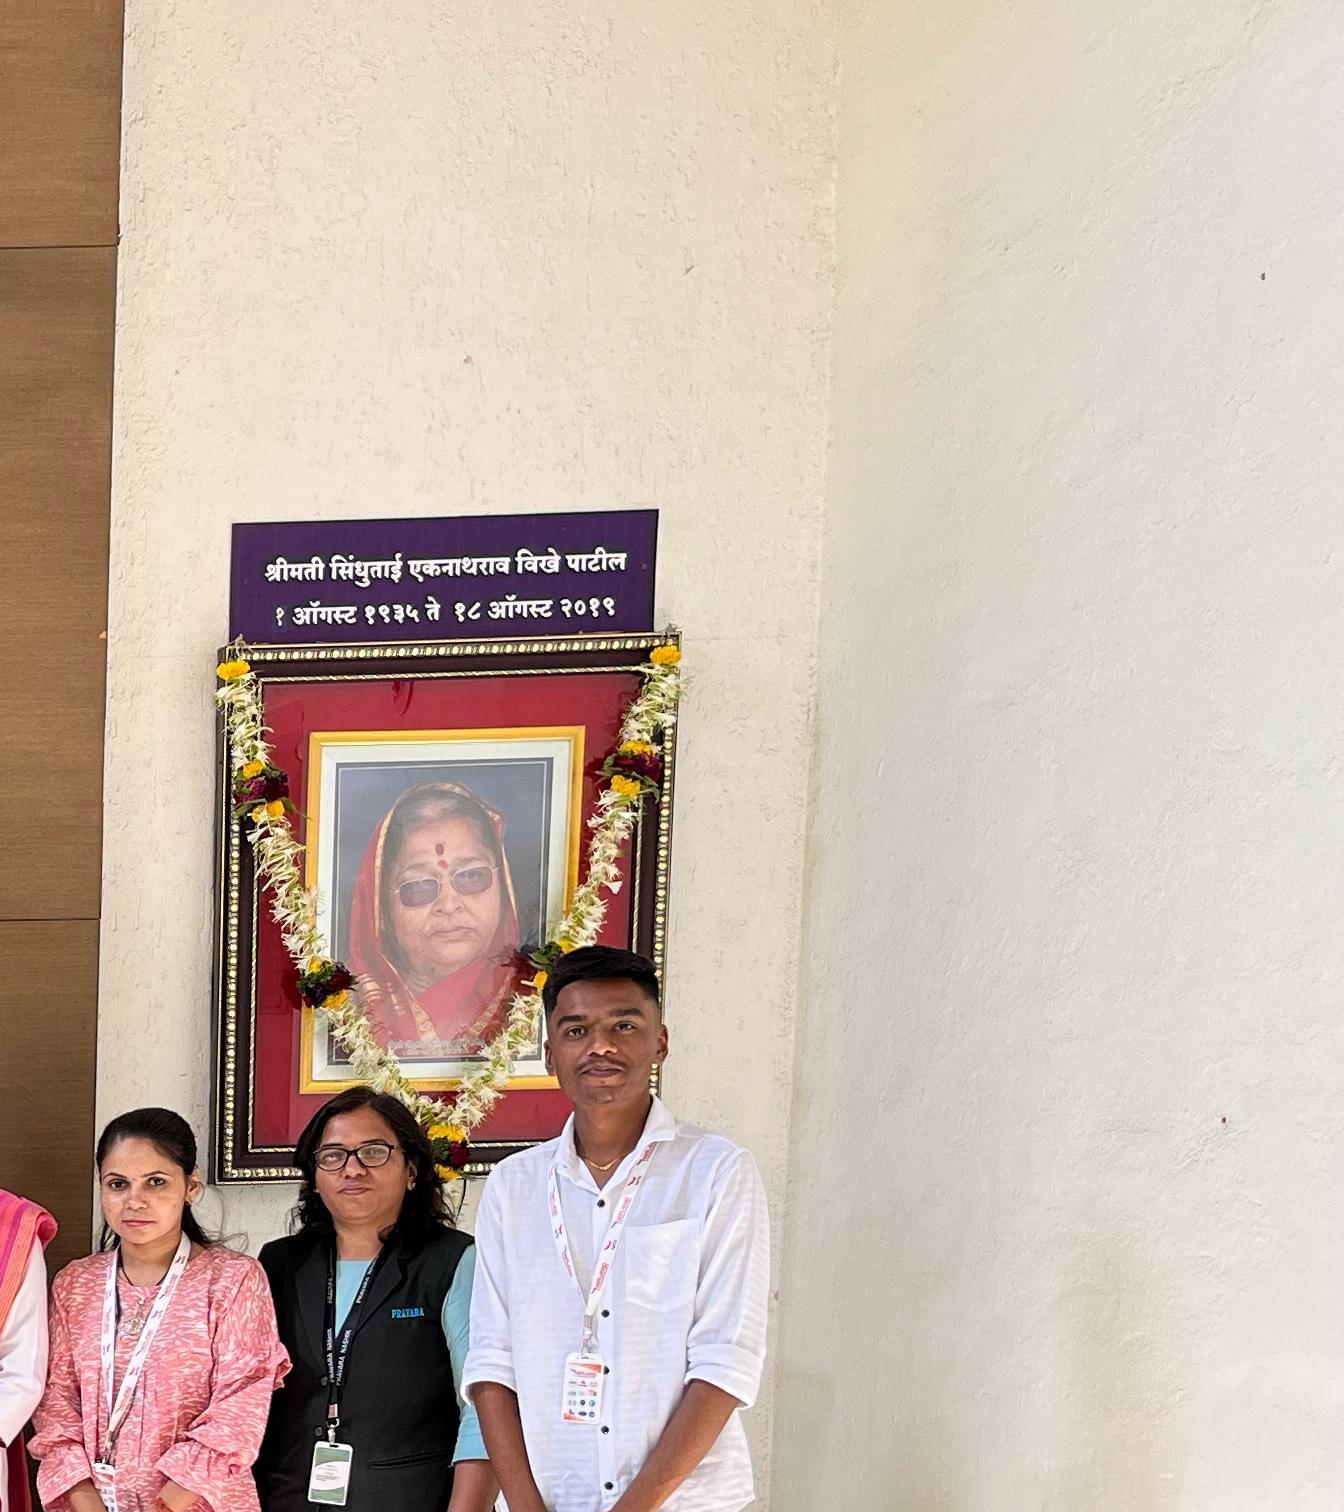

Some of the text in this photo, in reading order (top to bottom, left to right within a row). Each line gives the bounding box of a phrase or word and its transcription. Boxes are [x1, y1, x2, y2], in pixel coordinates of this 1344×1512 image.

[264, 546, 628, 588] श्रीमती सिंधुताई एकनाथराव विखे पाटील
[275, 594, 615, 627] १ ऑगस्ट १९३५ ते १८ ऑगस्ट २०१९
[391, 1306, 425, 1319] PRAVARA
